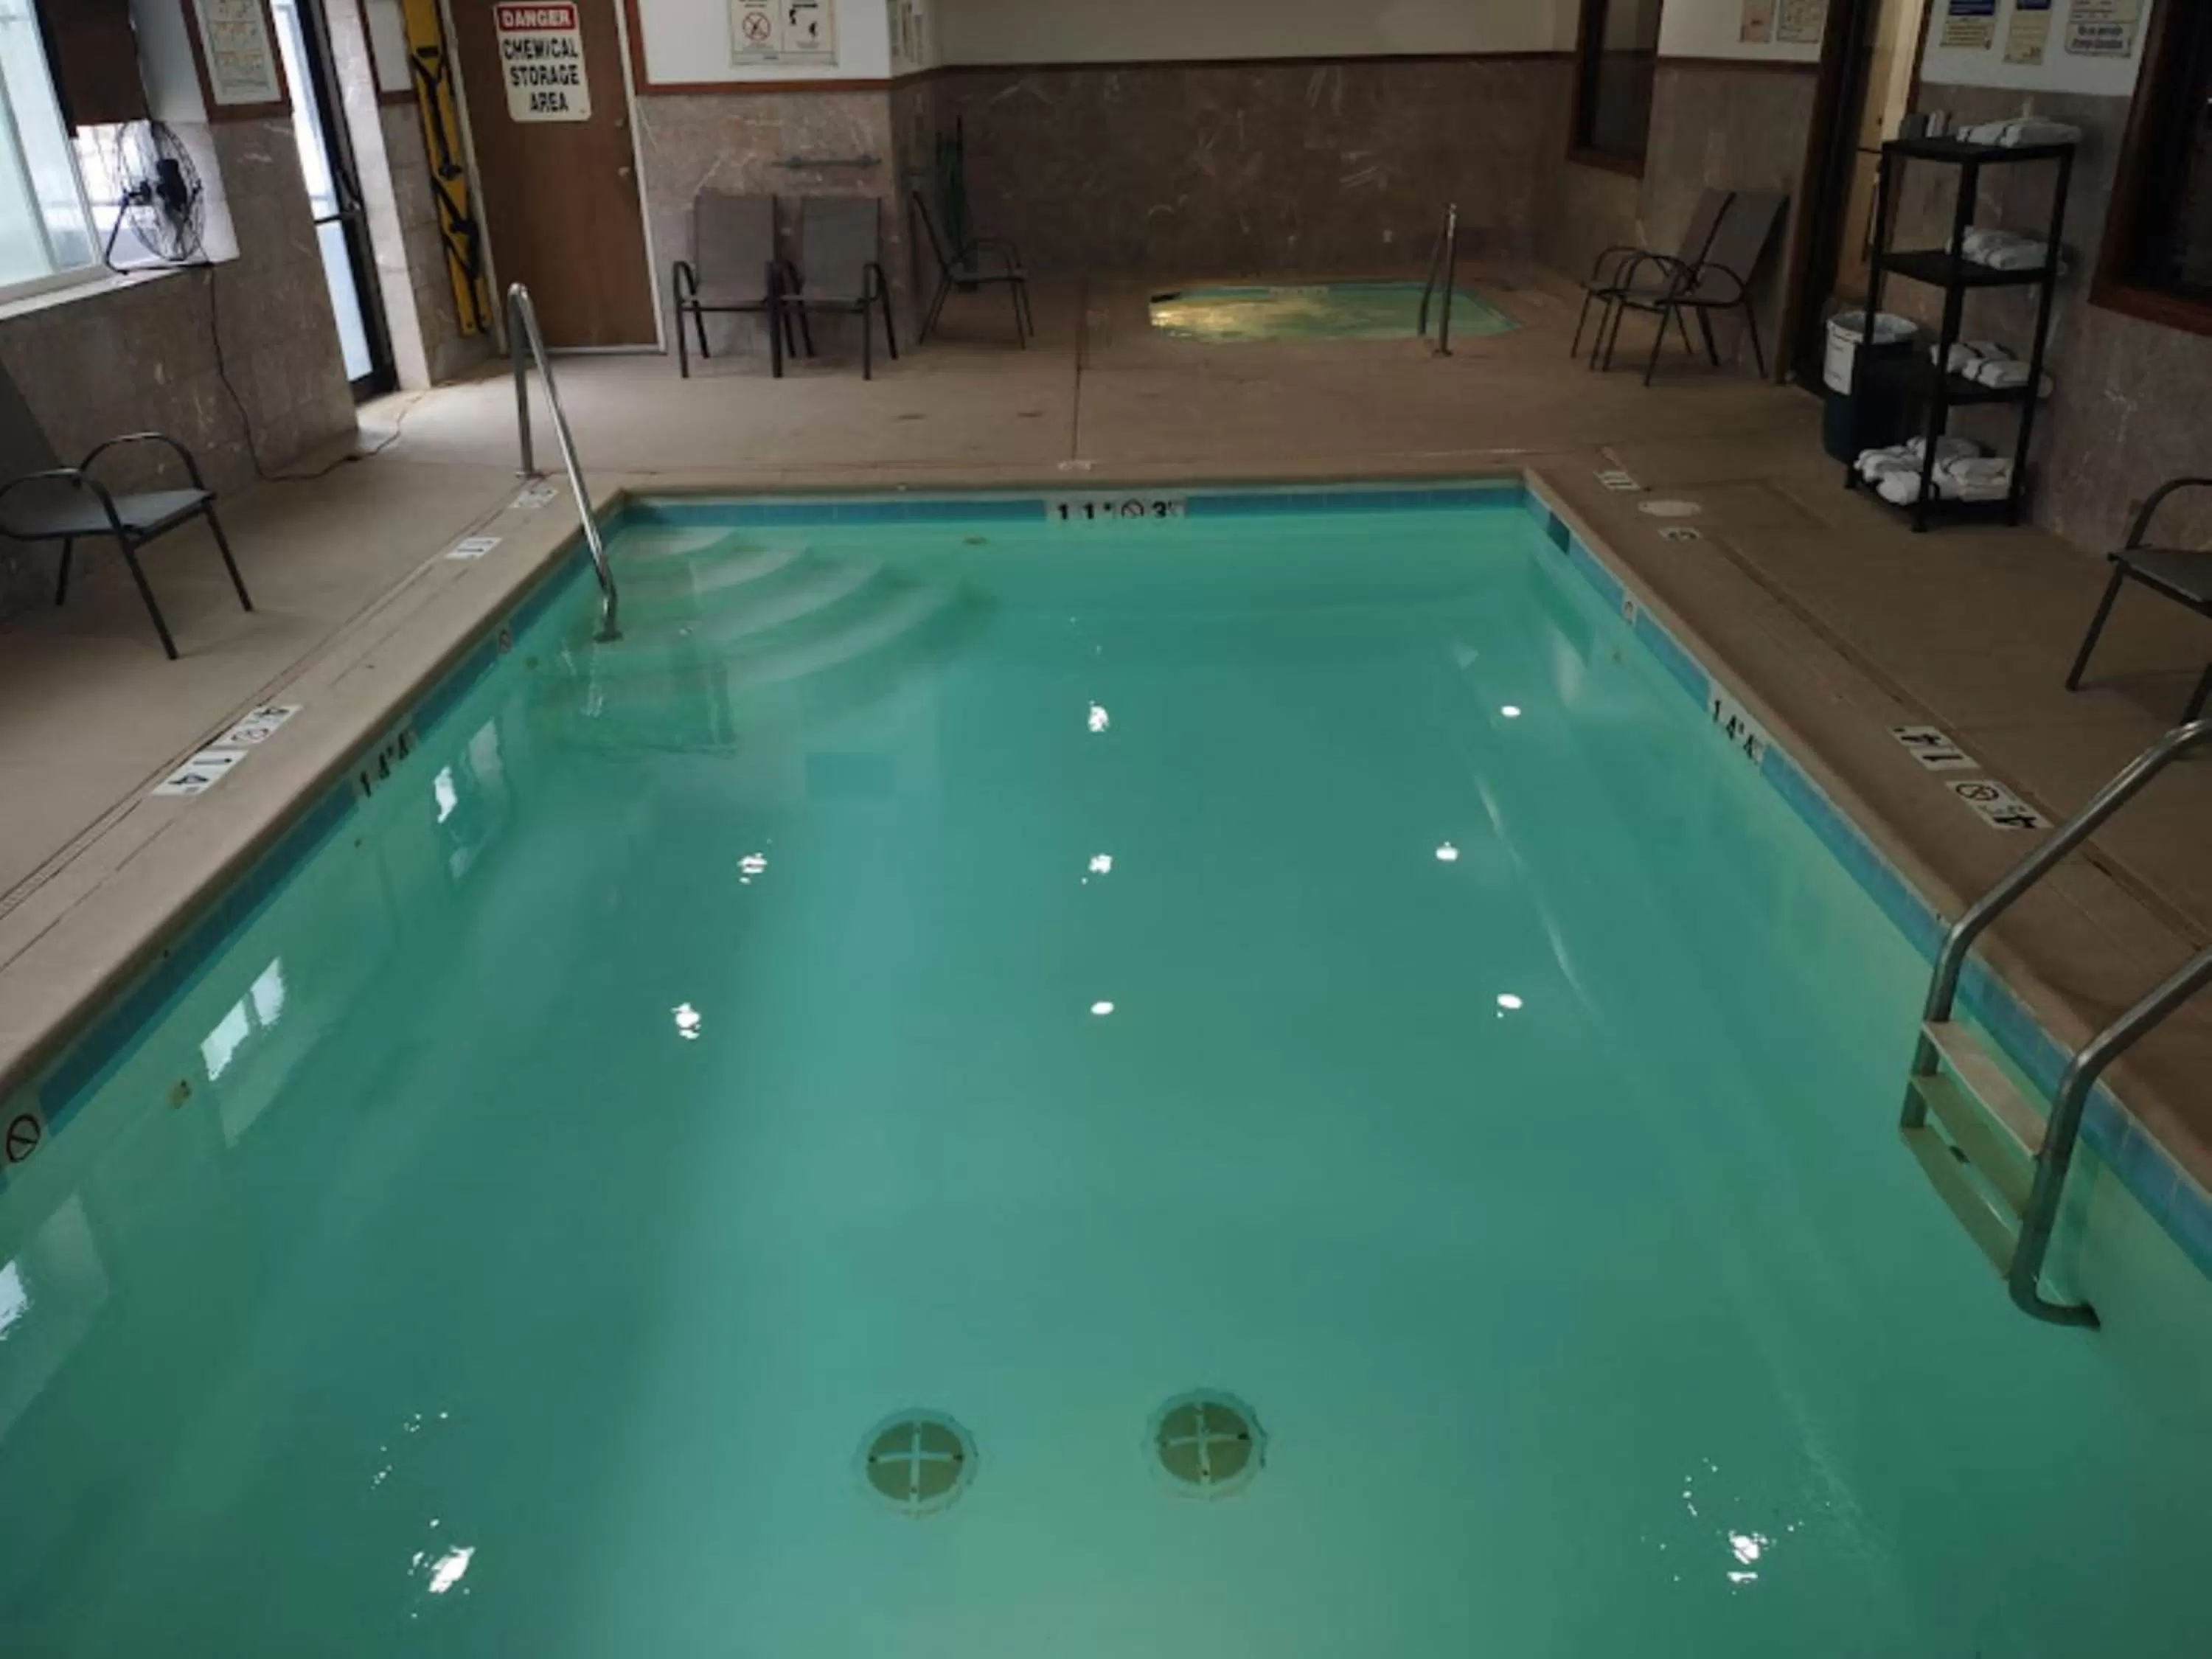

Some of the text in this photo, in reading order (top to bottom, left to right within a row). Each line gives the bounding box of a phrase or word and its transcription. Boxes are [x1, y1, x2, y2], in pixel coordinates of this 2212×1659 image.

[501, 9, 571, 27] DANGER
[504, 38, 579, 60] CHEMICAL
[510, 64, 580, 86] STORAGE
[530, 91, 569, 112] AREA
